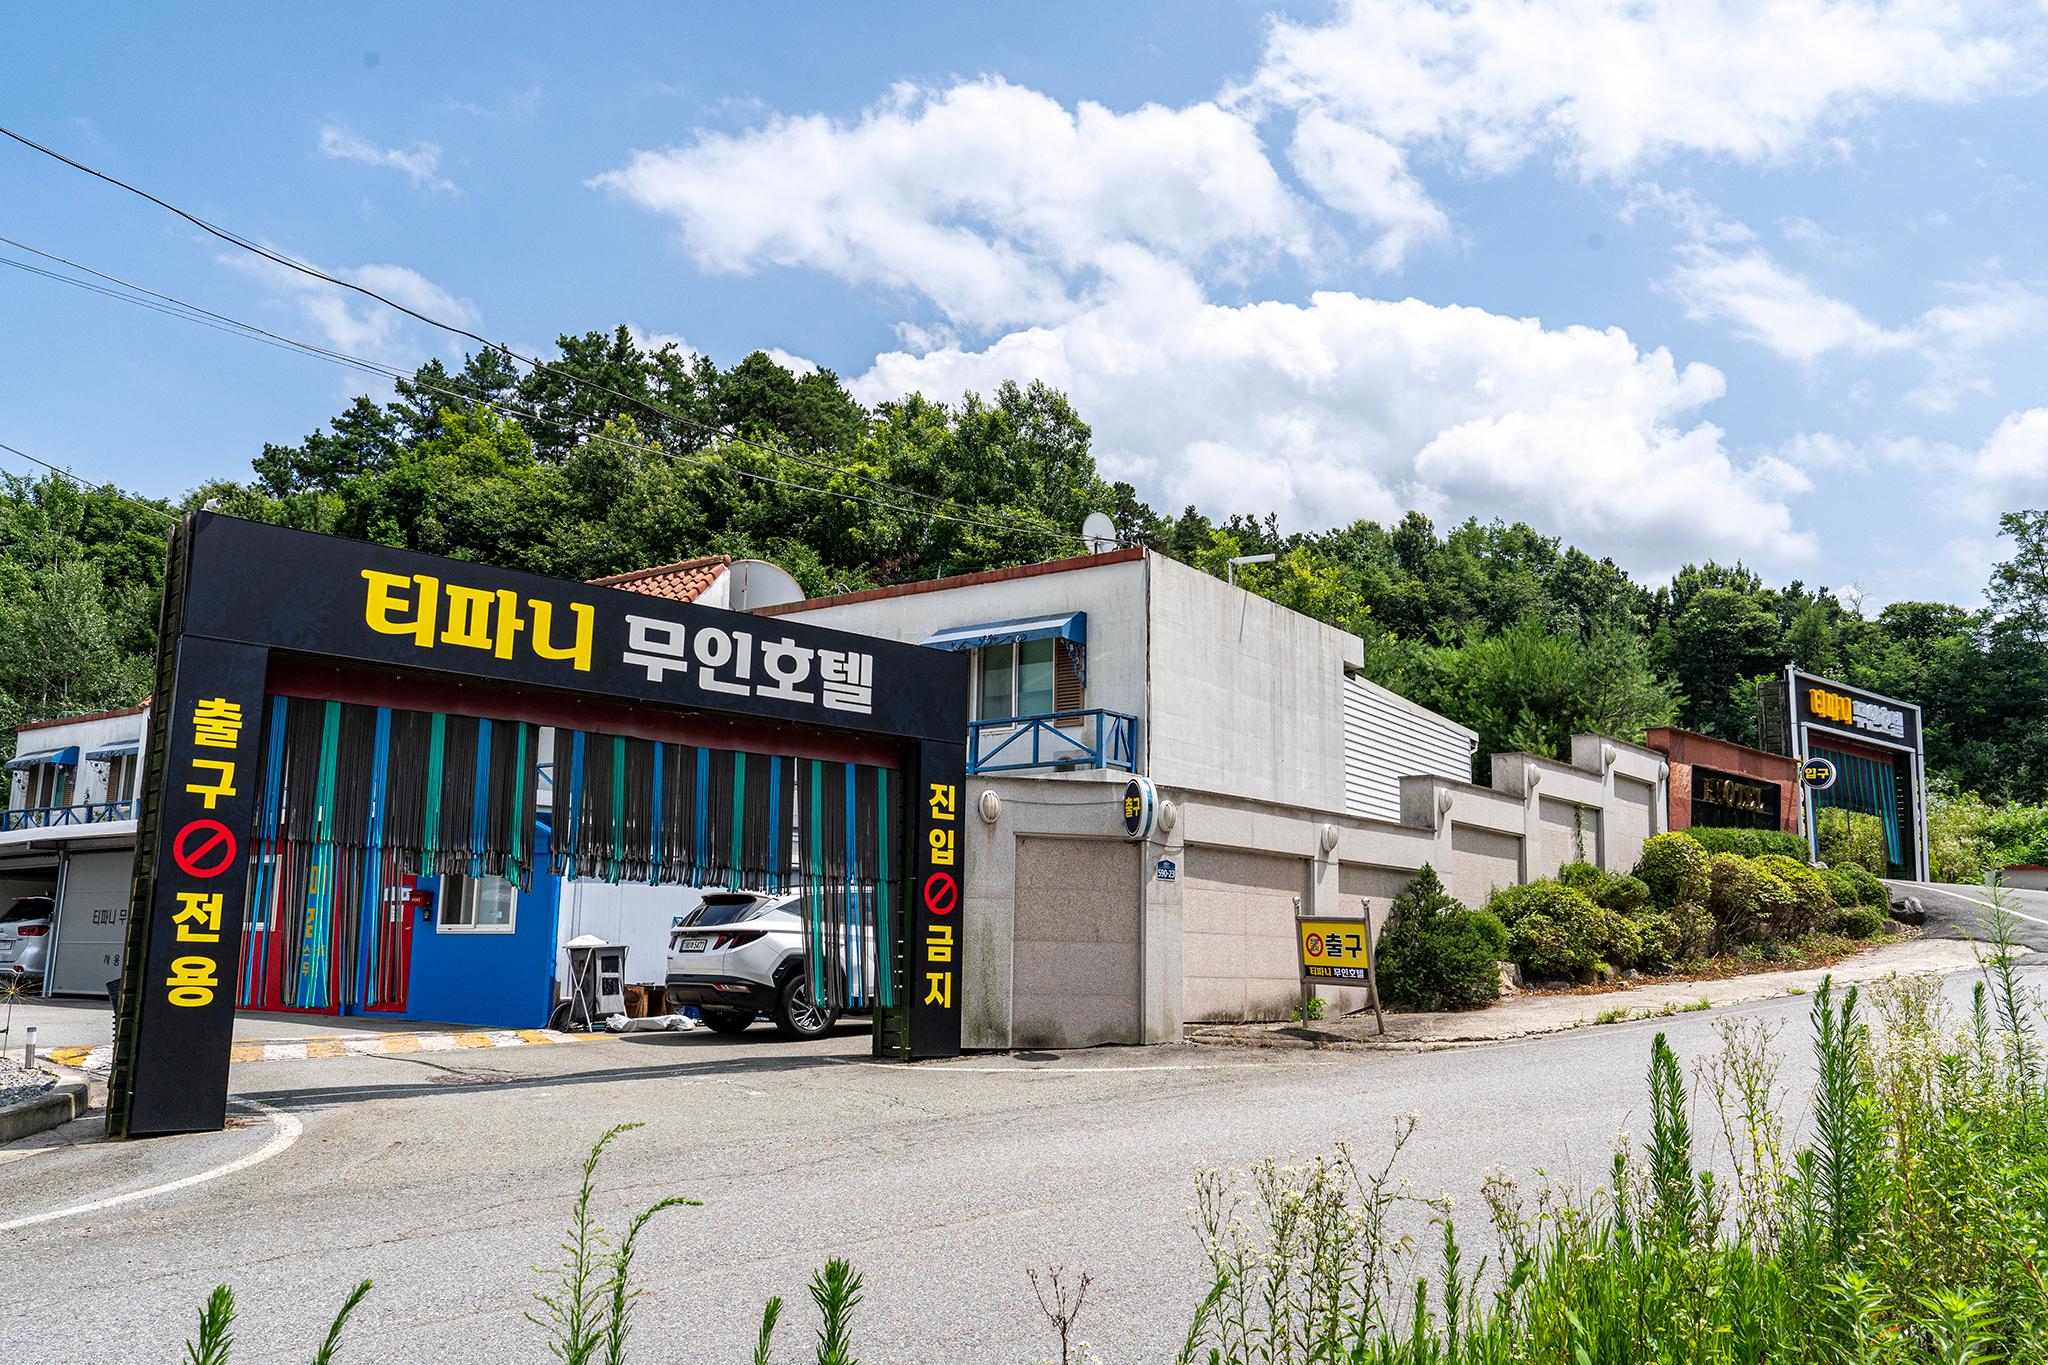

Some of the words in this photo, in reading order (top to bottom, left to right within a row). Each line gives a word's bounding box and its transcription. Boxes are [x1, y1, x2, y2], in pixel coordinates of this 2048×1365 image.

[361, 569, 595, 672] 티파니
[623, 614, 873, 714] 무인호텔
[1808, 688, 1852, 725] 티파니
[186, 697, 242, 809] 출구
[1804, 767, 1830, 780] 입구
[929, 783, 956, 866] 진입
[1125, 796, 1141, 818] 출구
[1157, 868, 1176, 878] 590-23
[166, 892, 224, 1007] 전용
[1326, 933, 1363, 958] 출구
[924, 925, 954, 1009] 금지
[1309, 966, 1332, 977] 티파니
[1333, 968, 1365, 979] 무인호텔
